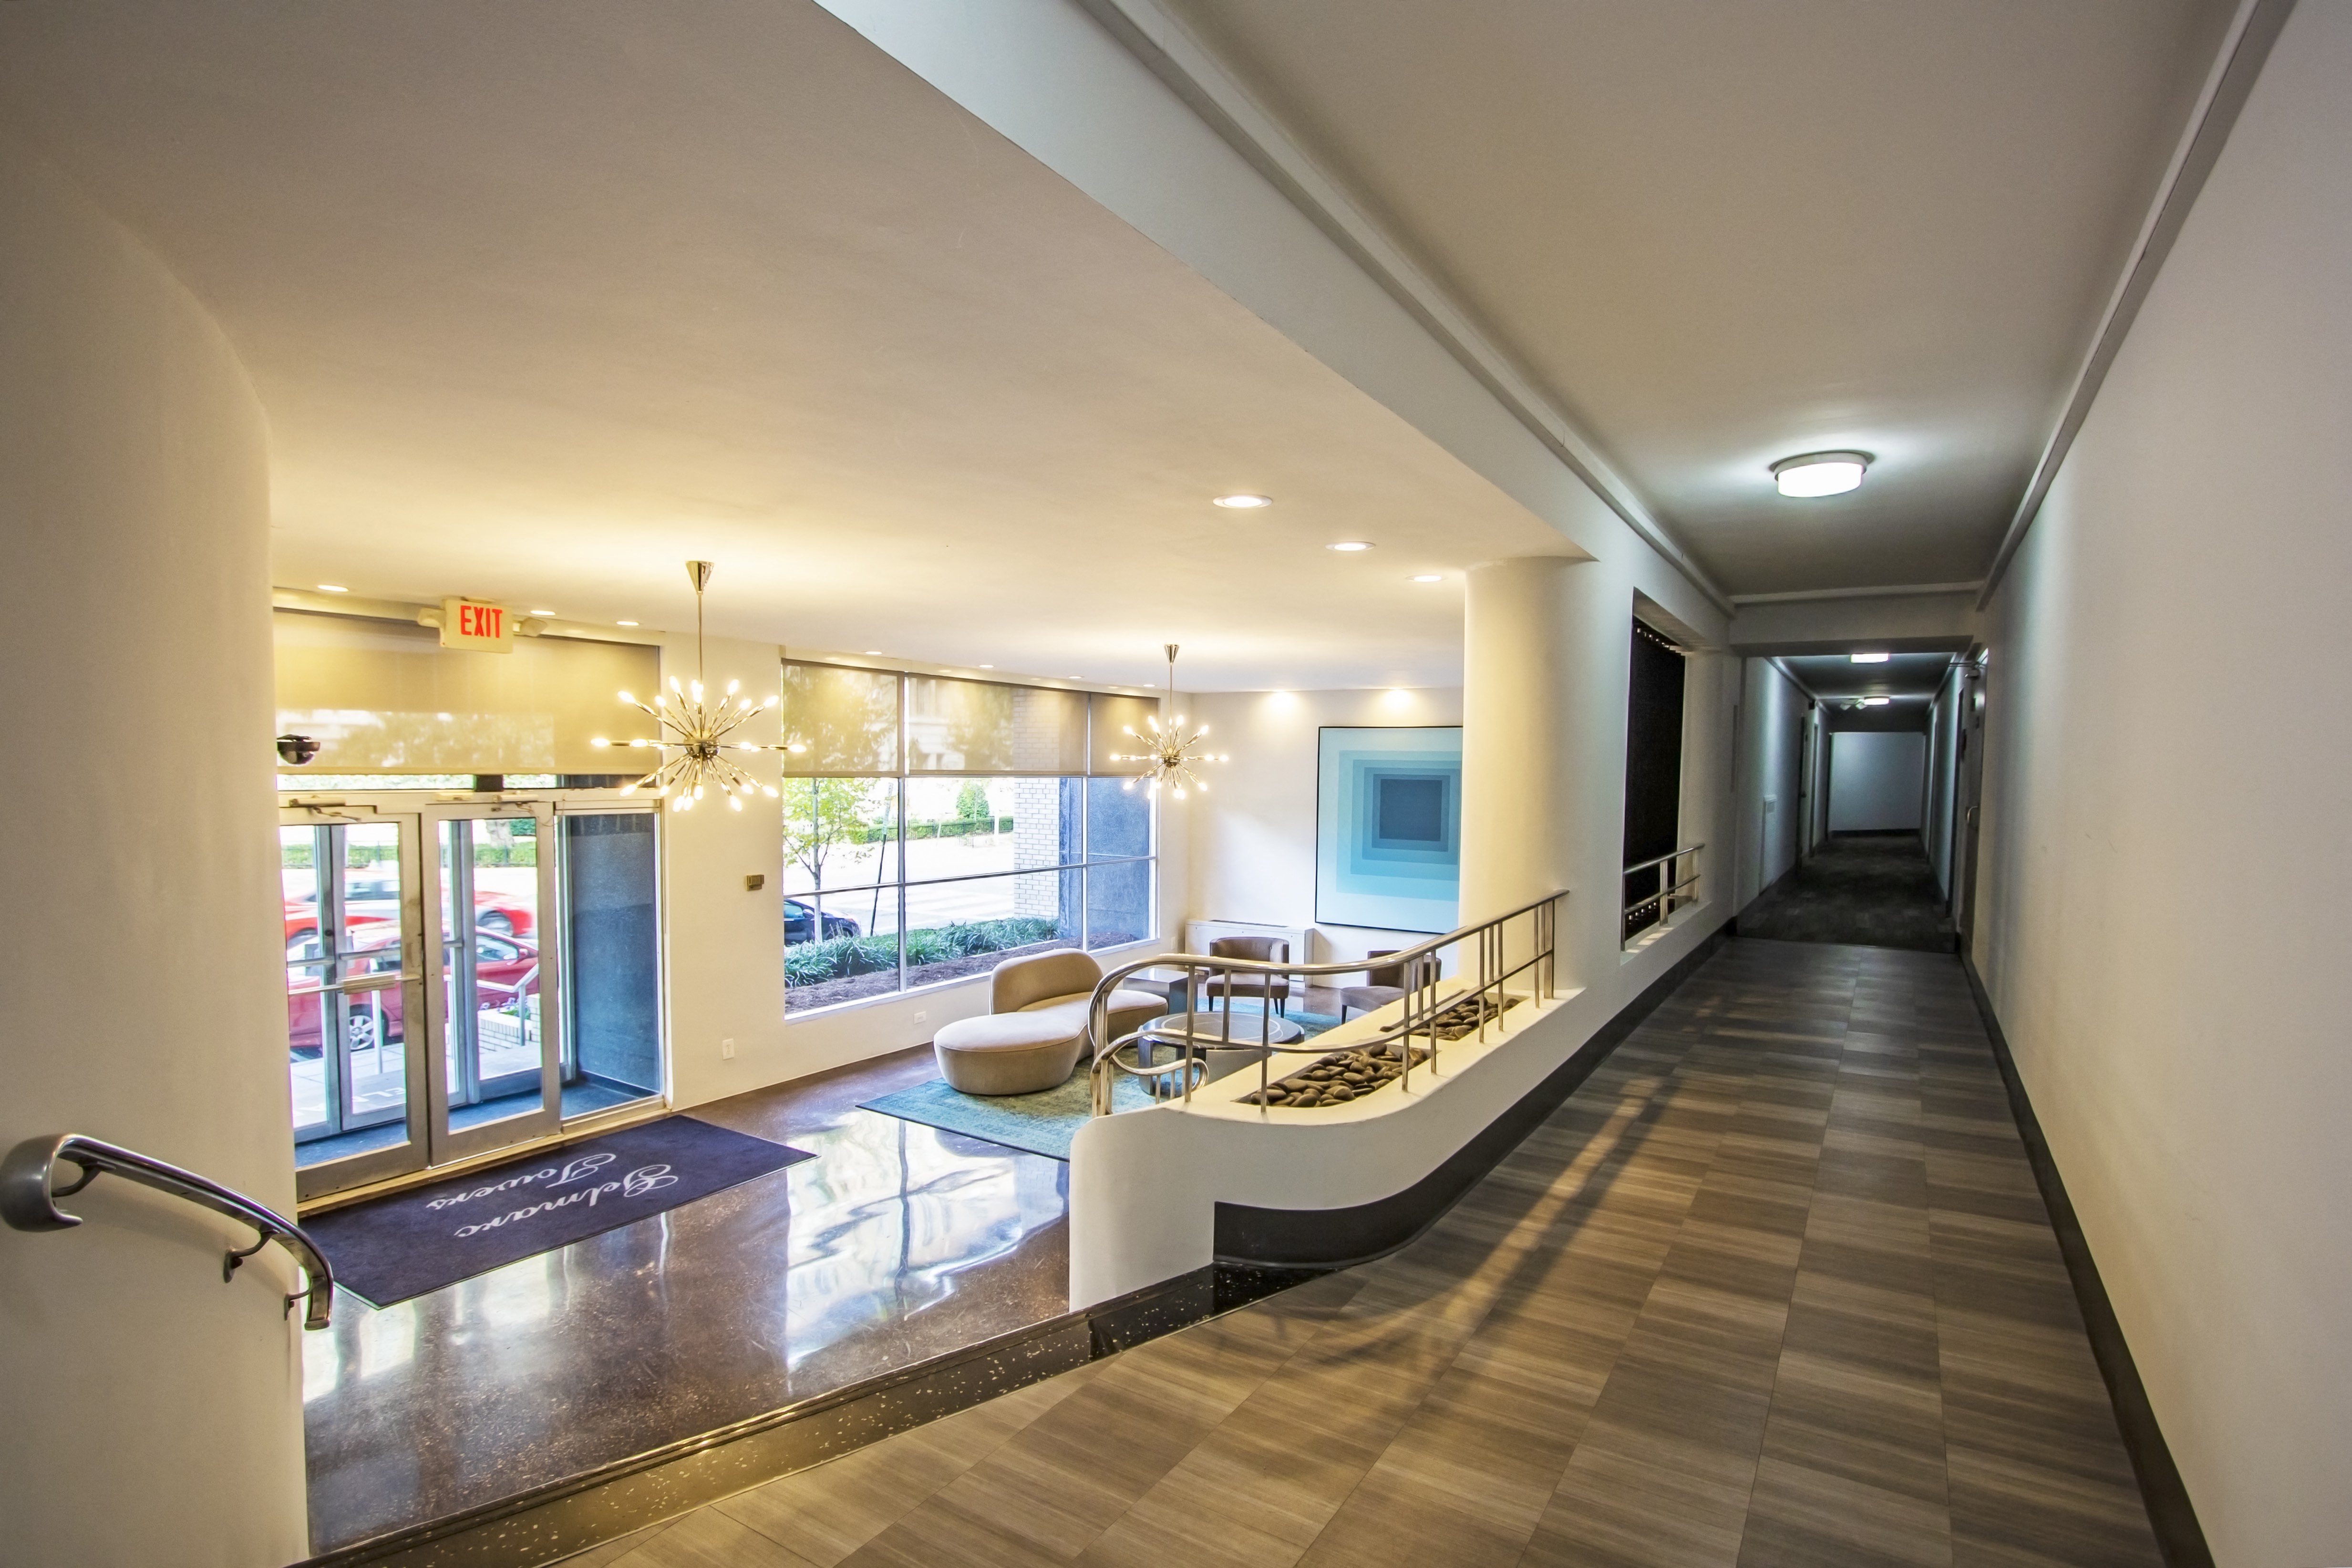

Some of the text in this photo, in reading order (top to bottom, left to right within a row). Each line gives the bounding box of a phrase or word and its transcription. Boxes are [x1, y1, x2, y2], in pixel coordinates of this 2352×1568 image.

[460, 605, 503, 639] EXIT
[425, 1153, 617, 1210] Towers
[454, 1164, 679, 1238] Gelmarc
